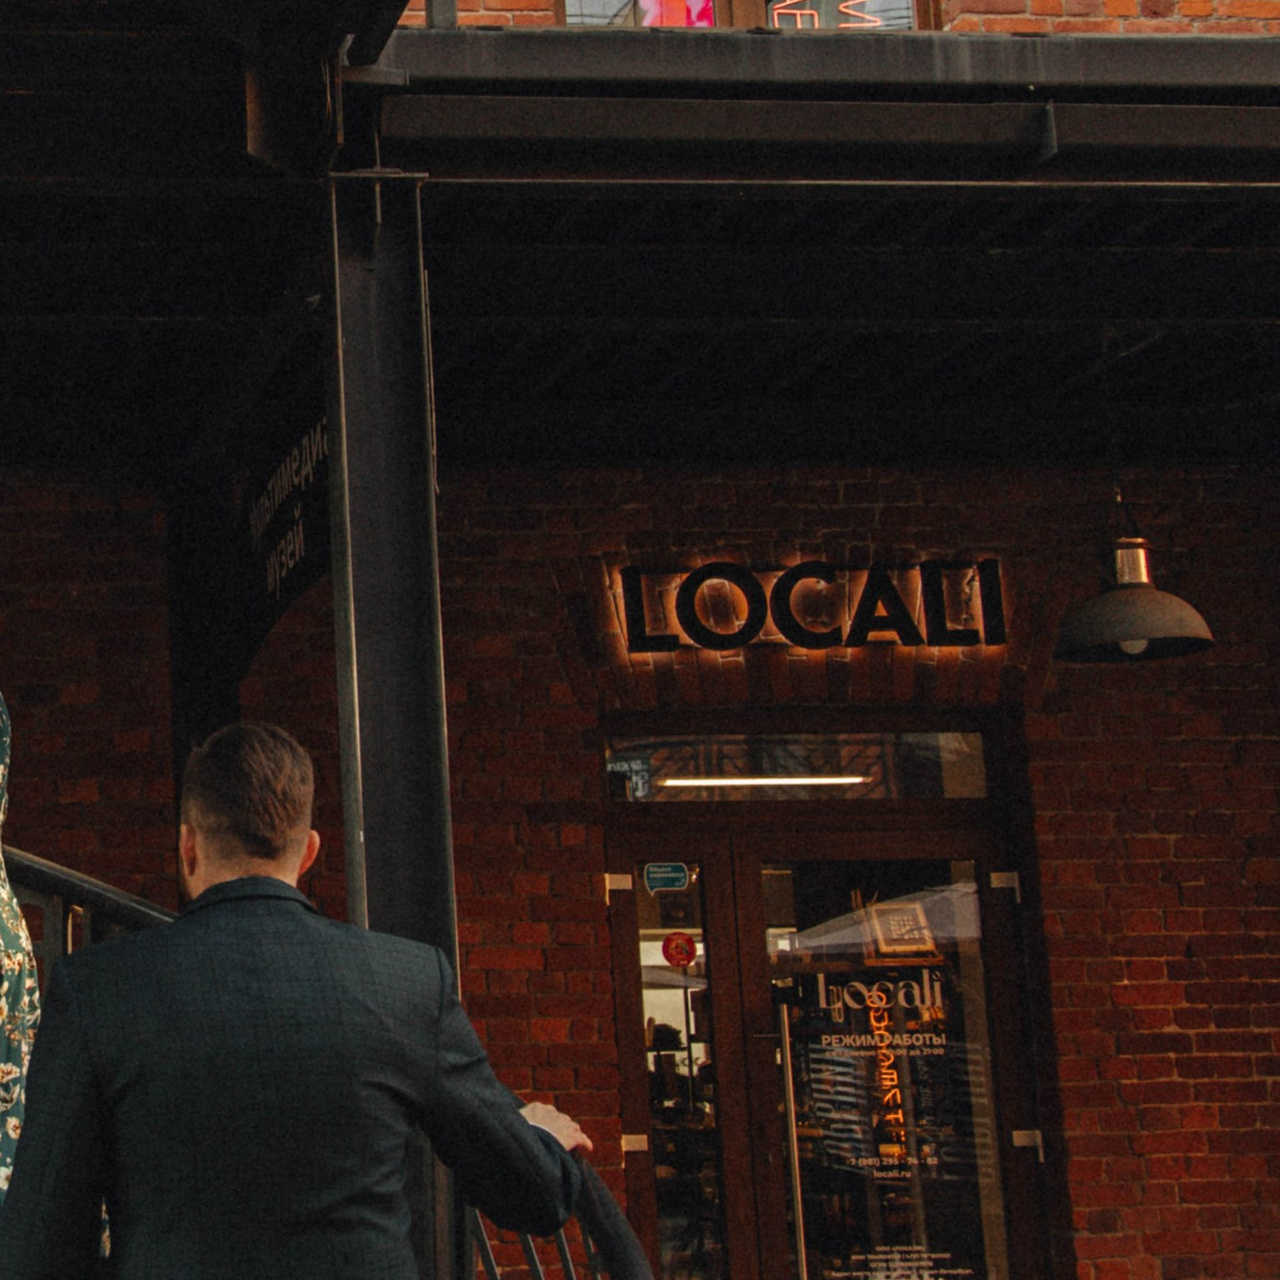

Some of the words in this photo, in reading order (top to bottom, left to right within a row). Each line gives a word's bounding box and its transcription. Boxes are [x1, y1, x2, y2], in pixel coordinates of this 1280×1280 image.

[620, 559, 1007, 653] LOCALI
[821, 1035, 882, 1047] РЕЖИМ
[883, 1033, 947, 1046] РАБОТЫ
